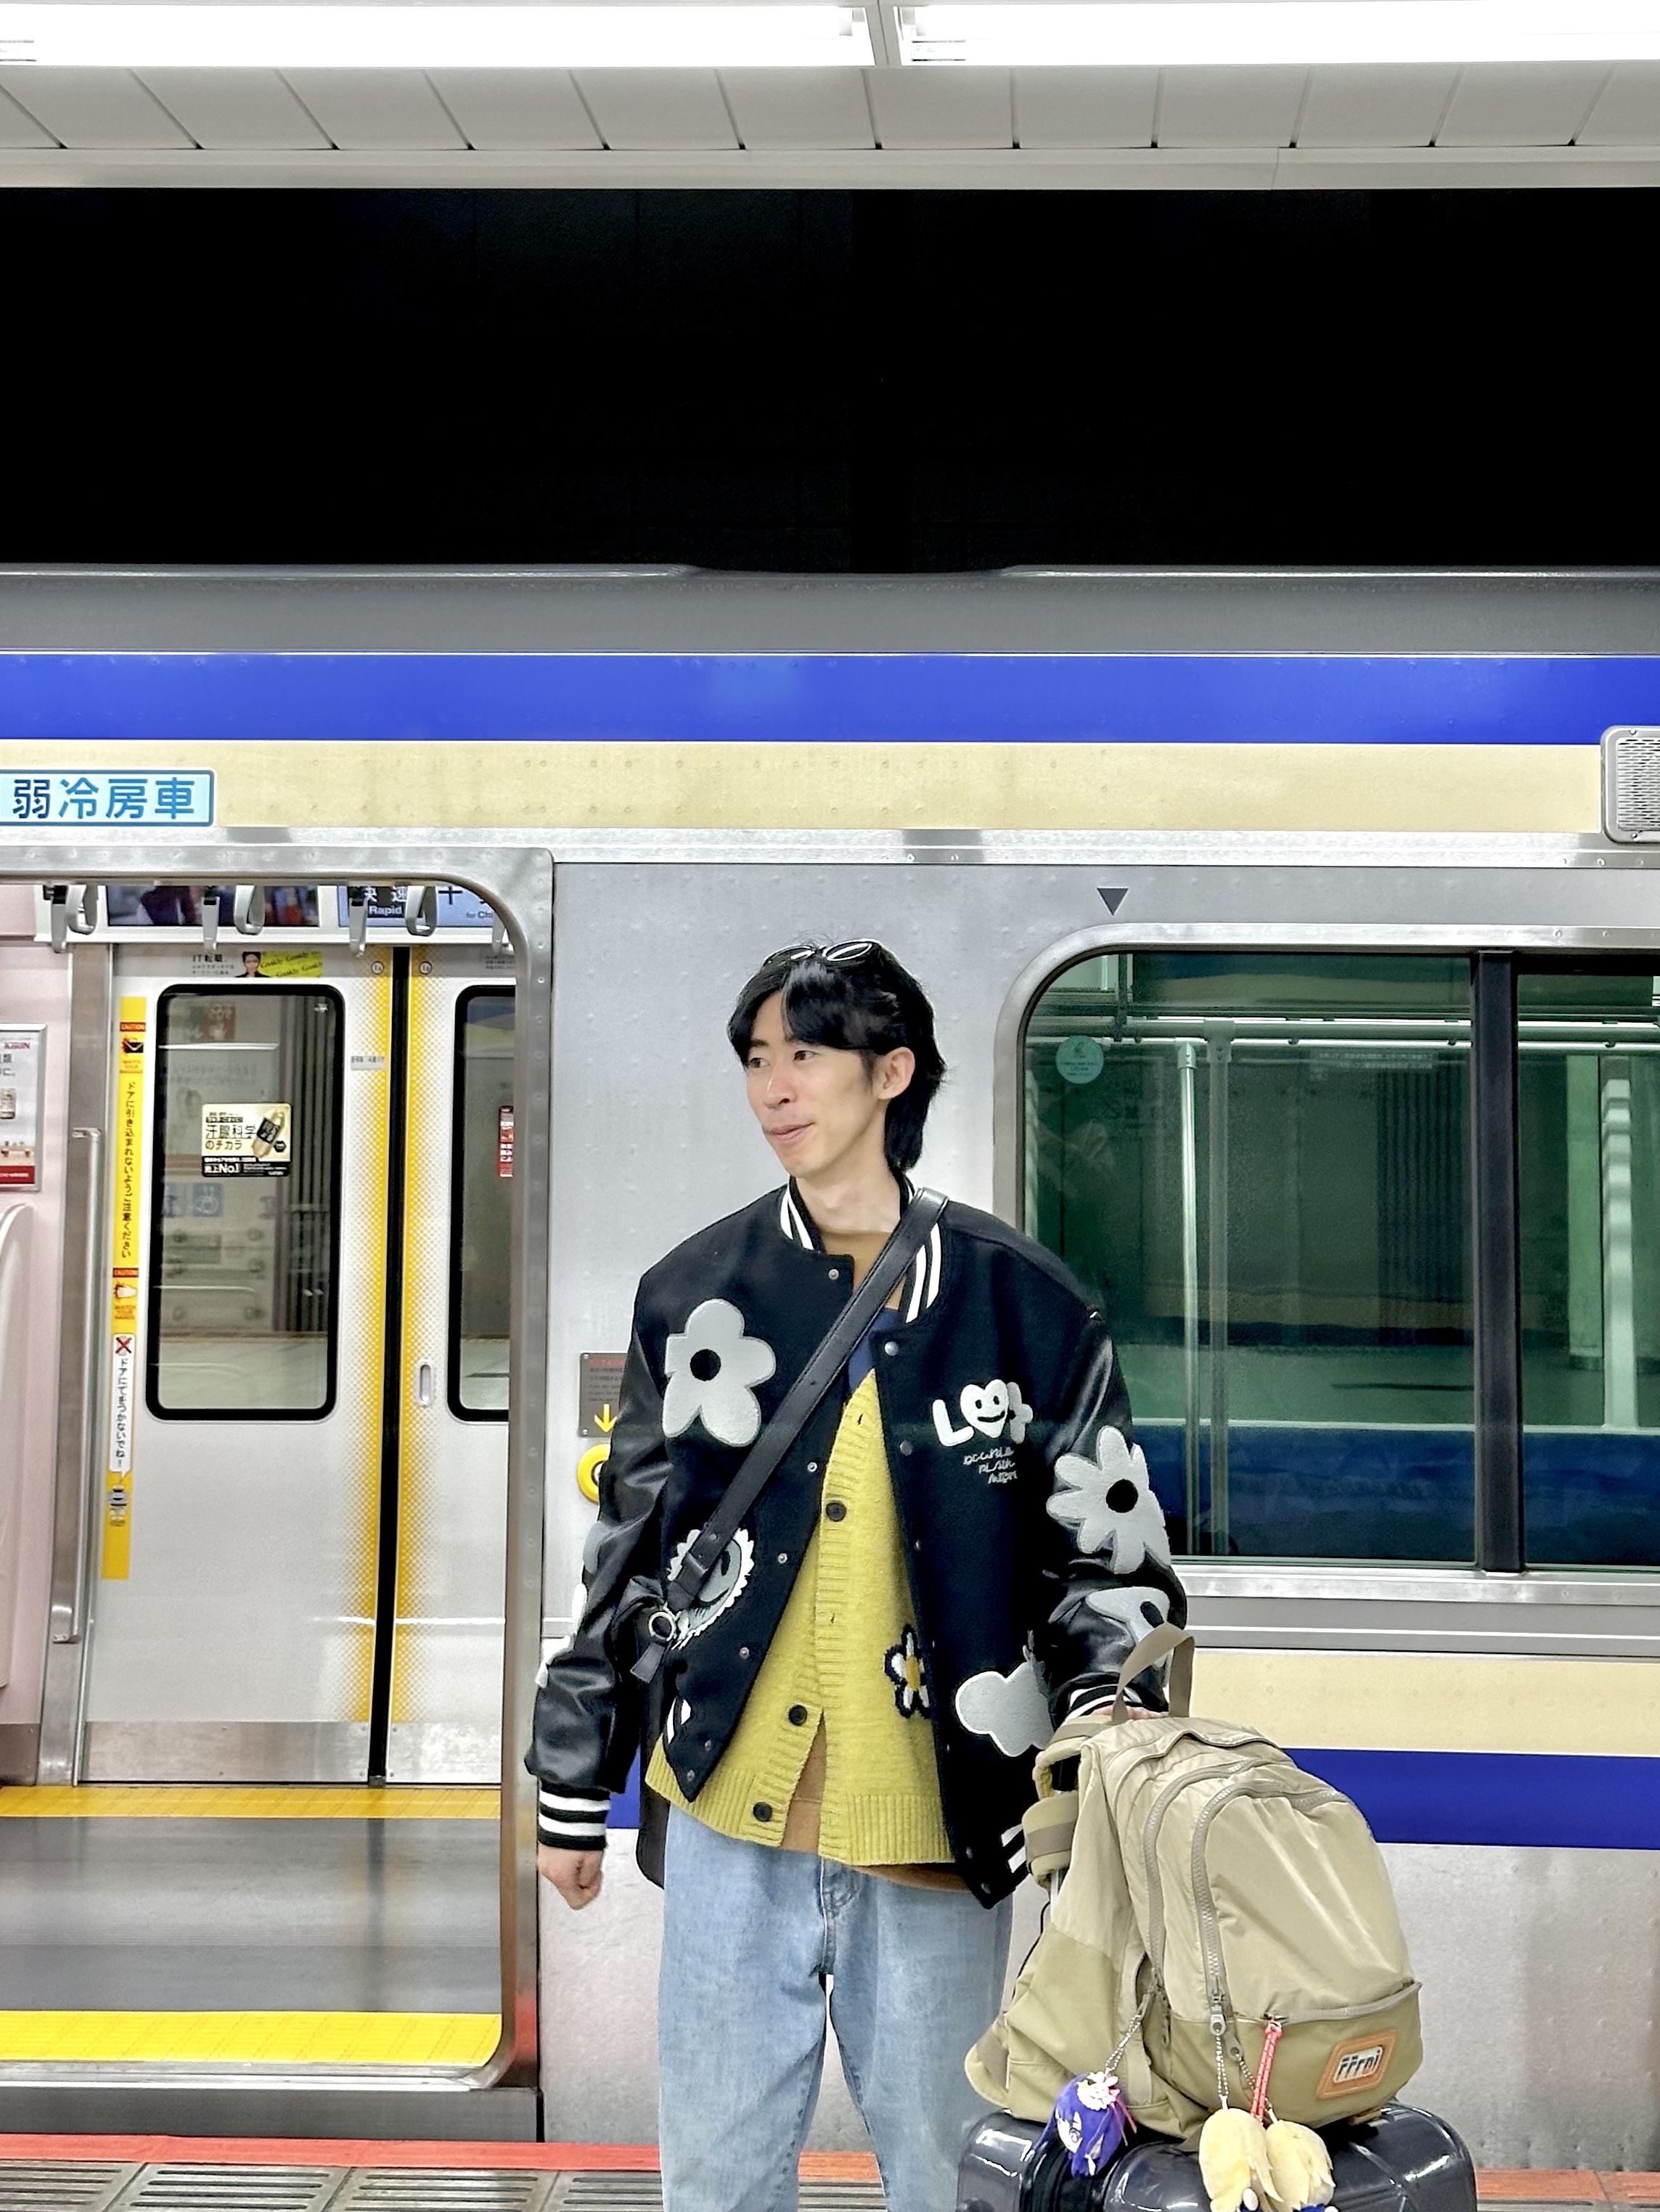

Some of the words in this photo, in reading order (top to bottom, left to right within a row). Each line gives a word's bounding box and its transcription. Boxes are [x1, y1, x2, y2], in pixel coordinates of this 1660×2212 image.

[12, 777, 195, 819] 弱冷房車
[369, 905, 403, 916] Rapid
[205, 1140, 242, 1150] のチカラ
